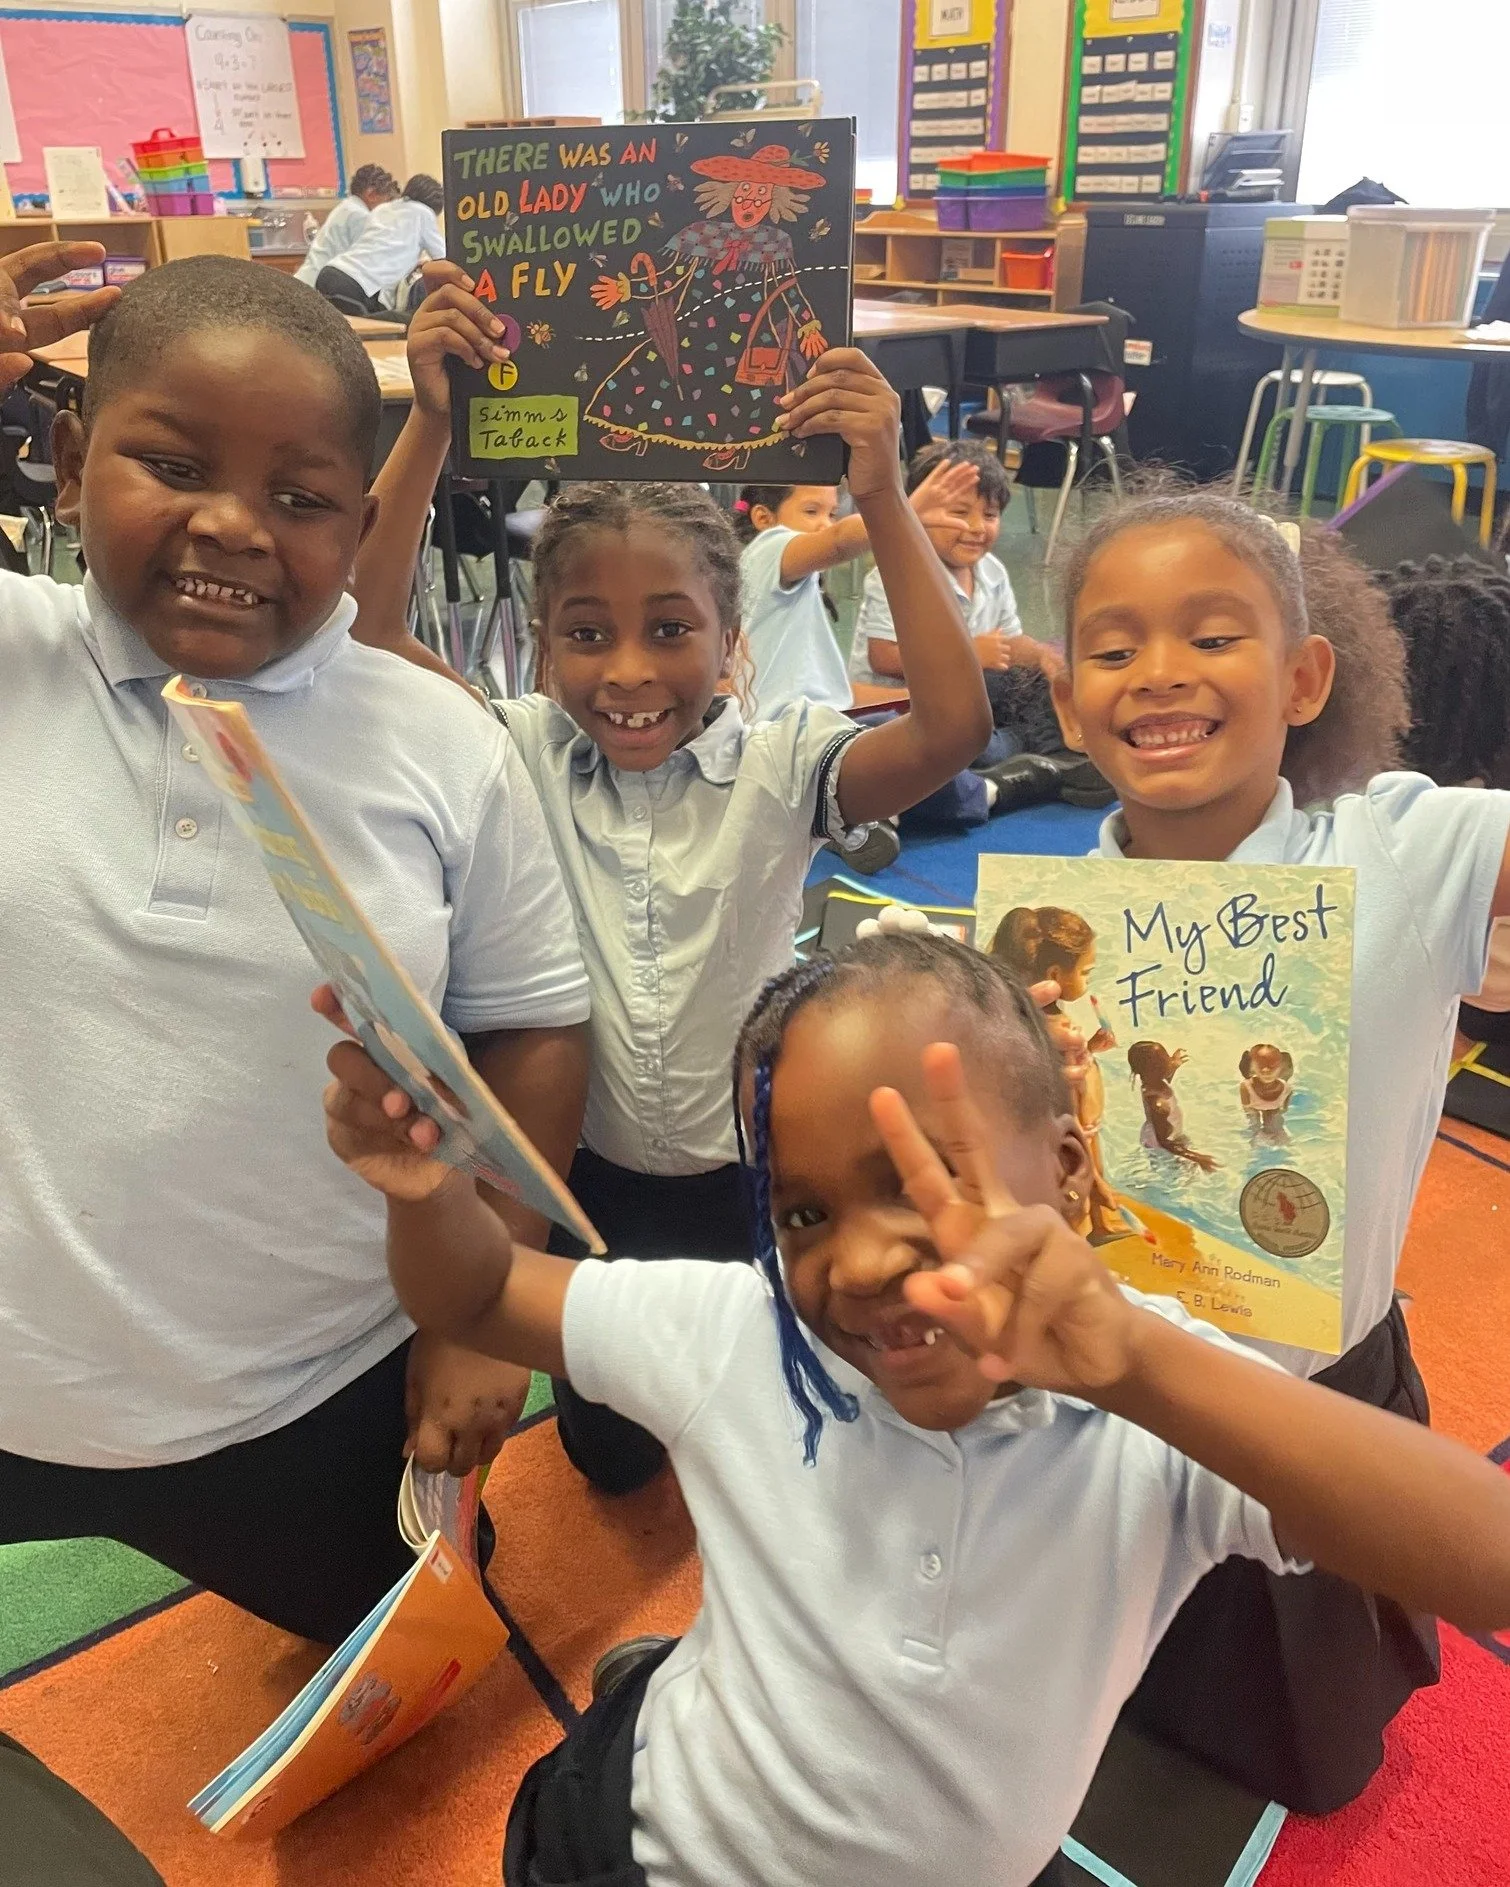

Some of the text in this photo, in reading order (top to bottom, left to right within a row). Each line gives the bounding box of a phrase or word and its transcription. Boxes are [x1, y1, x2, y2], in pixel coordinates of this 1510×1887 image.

[453, 138, 658, 179] THERE WAS AN
[457, 179, 661, 221] OLD LADY WHO
[462, 217, 642, 265] SWALLOWED
[474, 260, 578, 303] A FLY
[499, 363, 515, 385] F
[479, 405, 568, 424] Simms
[479, 427, 567, 450] Taback
[1123, 883, 1338, 976] My Best
[1116, 952, 1289, 1028] Friend
[1151, 1252, 1186, 1274] Mary
[1192, 1261, 1219, 1277] Ann
[1223, 1265, 1281, 1289] Rodman
[1211, 1297, 1253, 1318] Lewis
